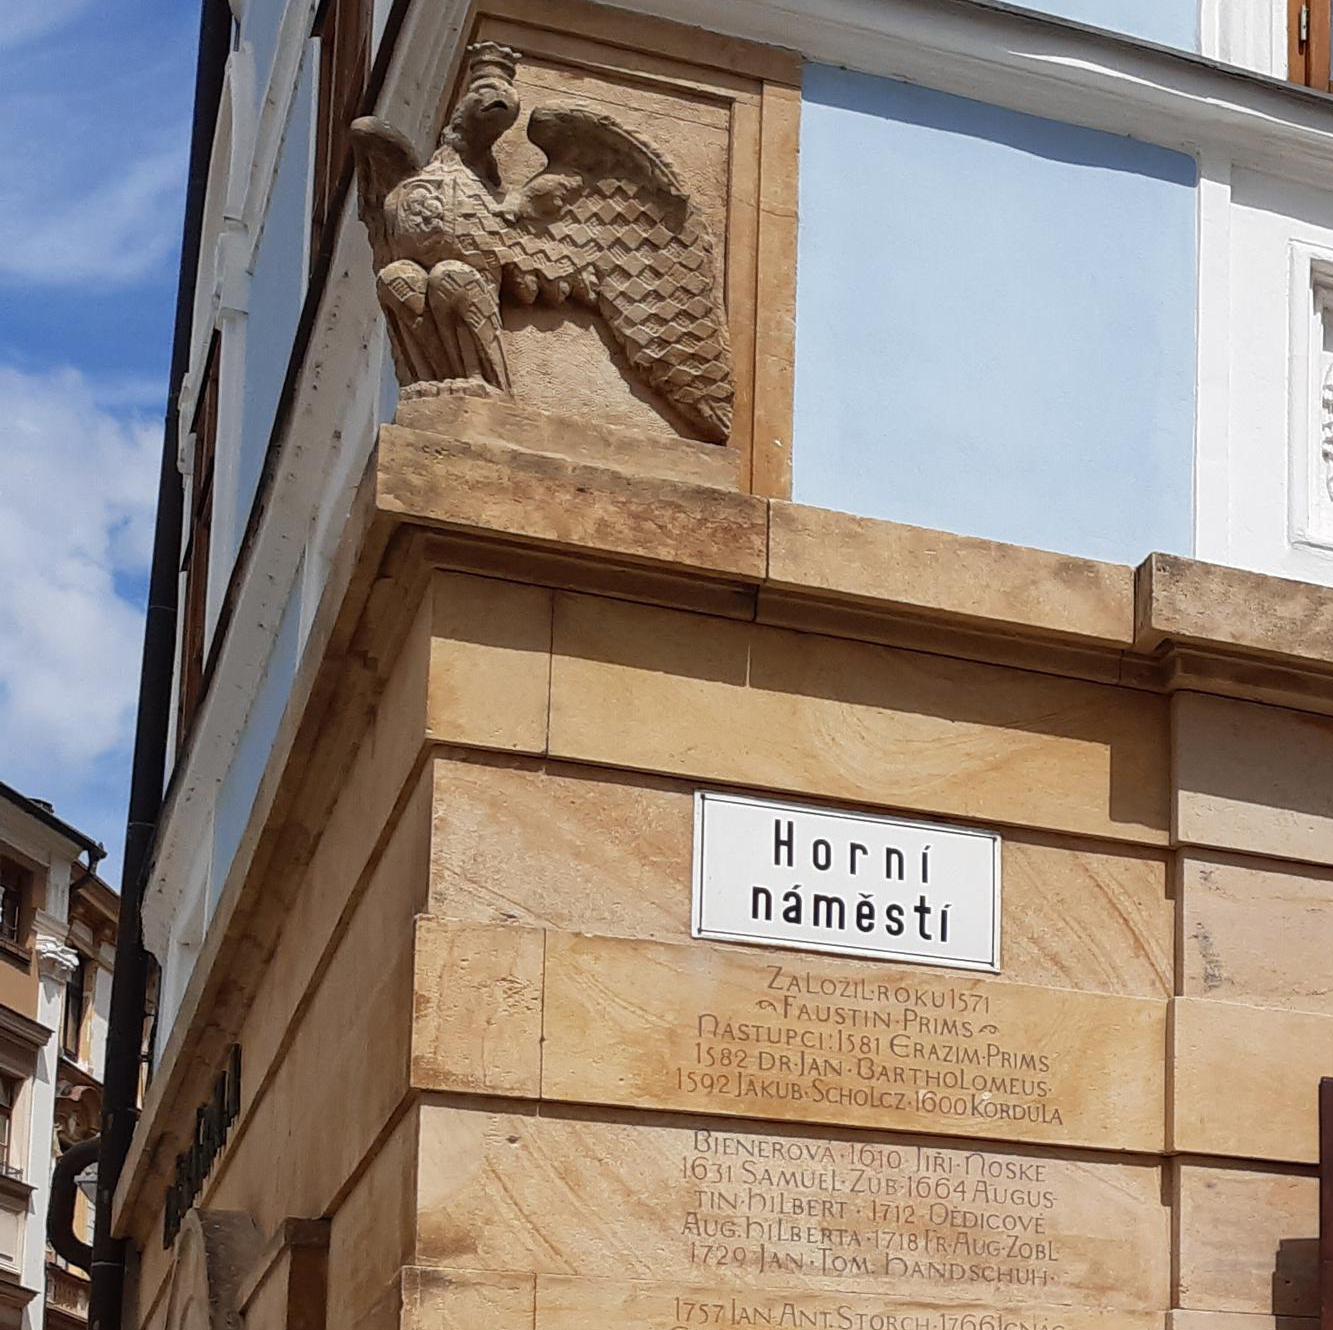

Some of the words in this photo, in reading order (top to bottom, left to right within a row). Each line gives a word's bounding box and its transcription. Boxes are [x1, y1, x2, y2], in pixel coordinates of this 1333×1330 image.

[774, 818, 931, 883] Horní
[752, 884, 952, 942] náměstí
[903, 1008, 973, 1037] PRIMS
[695, 1042, 748, 1069] 1582
[988, 1043, 1049, 1072] PRIMS
[675, 1068, 730, 1094] 1592
[681, 1156, 732, 1183] 1631
[908, 1176, 967, 1201] 1664
[872, 1200, 915, 1224] 1712
[674, 1297, 724, 1324] 1757
